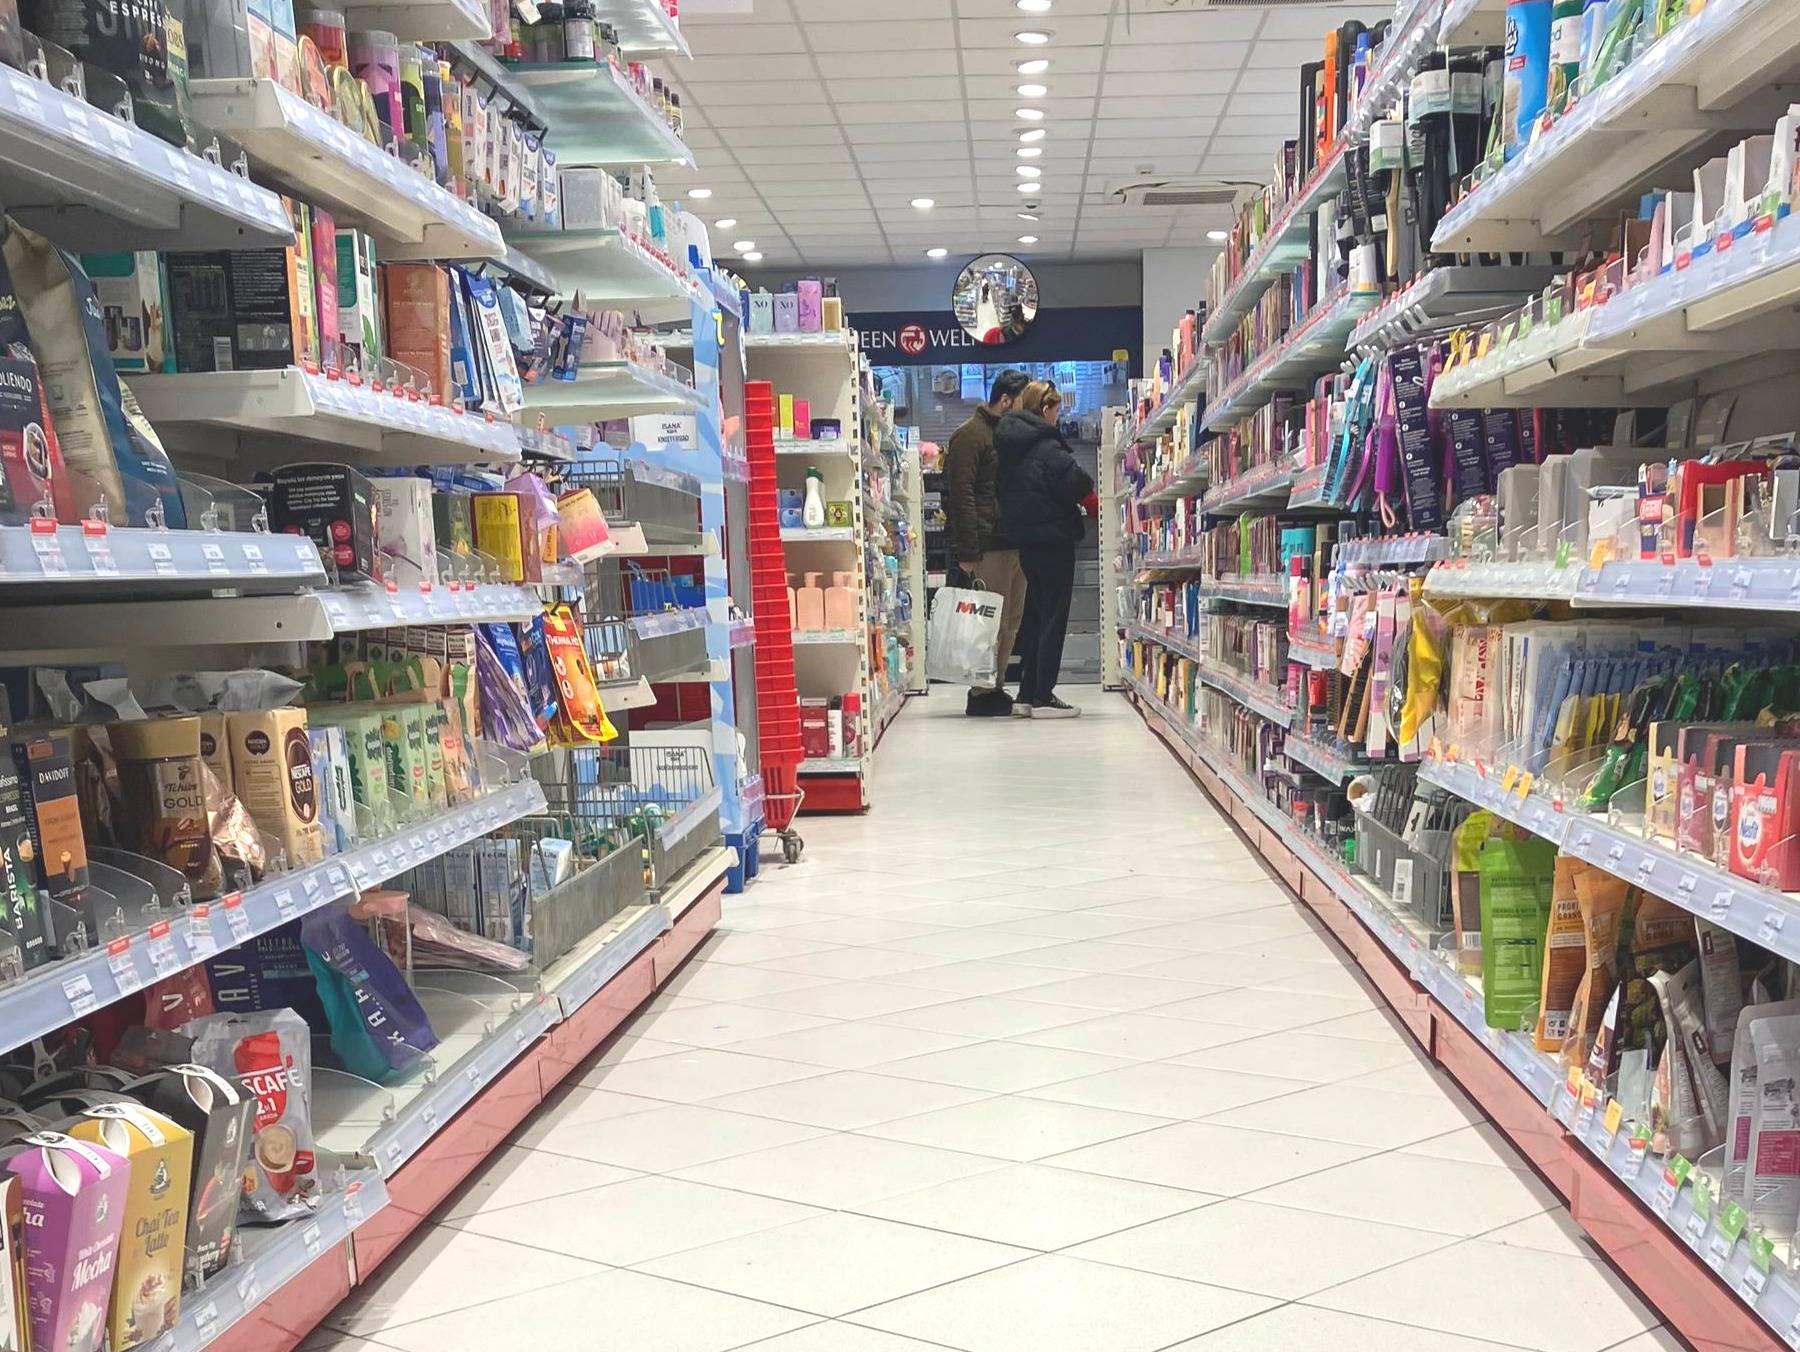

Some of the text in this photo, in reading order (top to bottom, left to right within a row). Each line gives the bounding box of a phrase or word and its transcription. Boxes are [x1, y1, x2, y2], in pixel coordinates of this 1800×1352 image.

[929, 329, 975, 348] WEL
[38, 767, 70, 785] DAVIDOFF
[164, 796, 203, 809] GOLD
[4, 846, 24, 930] BARISTA
[135, 1208, 180, 1238] Chai Tea
[144, 1233, 170, 1258] Latte
[70, 1250, 113, 1292] Mocha
